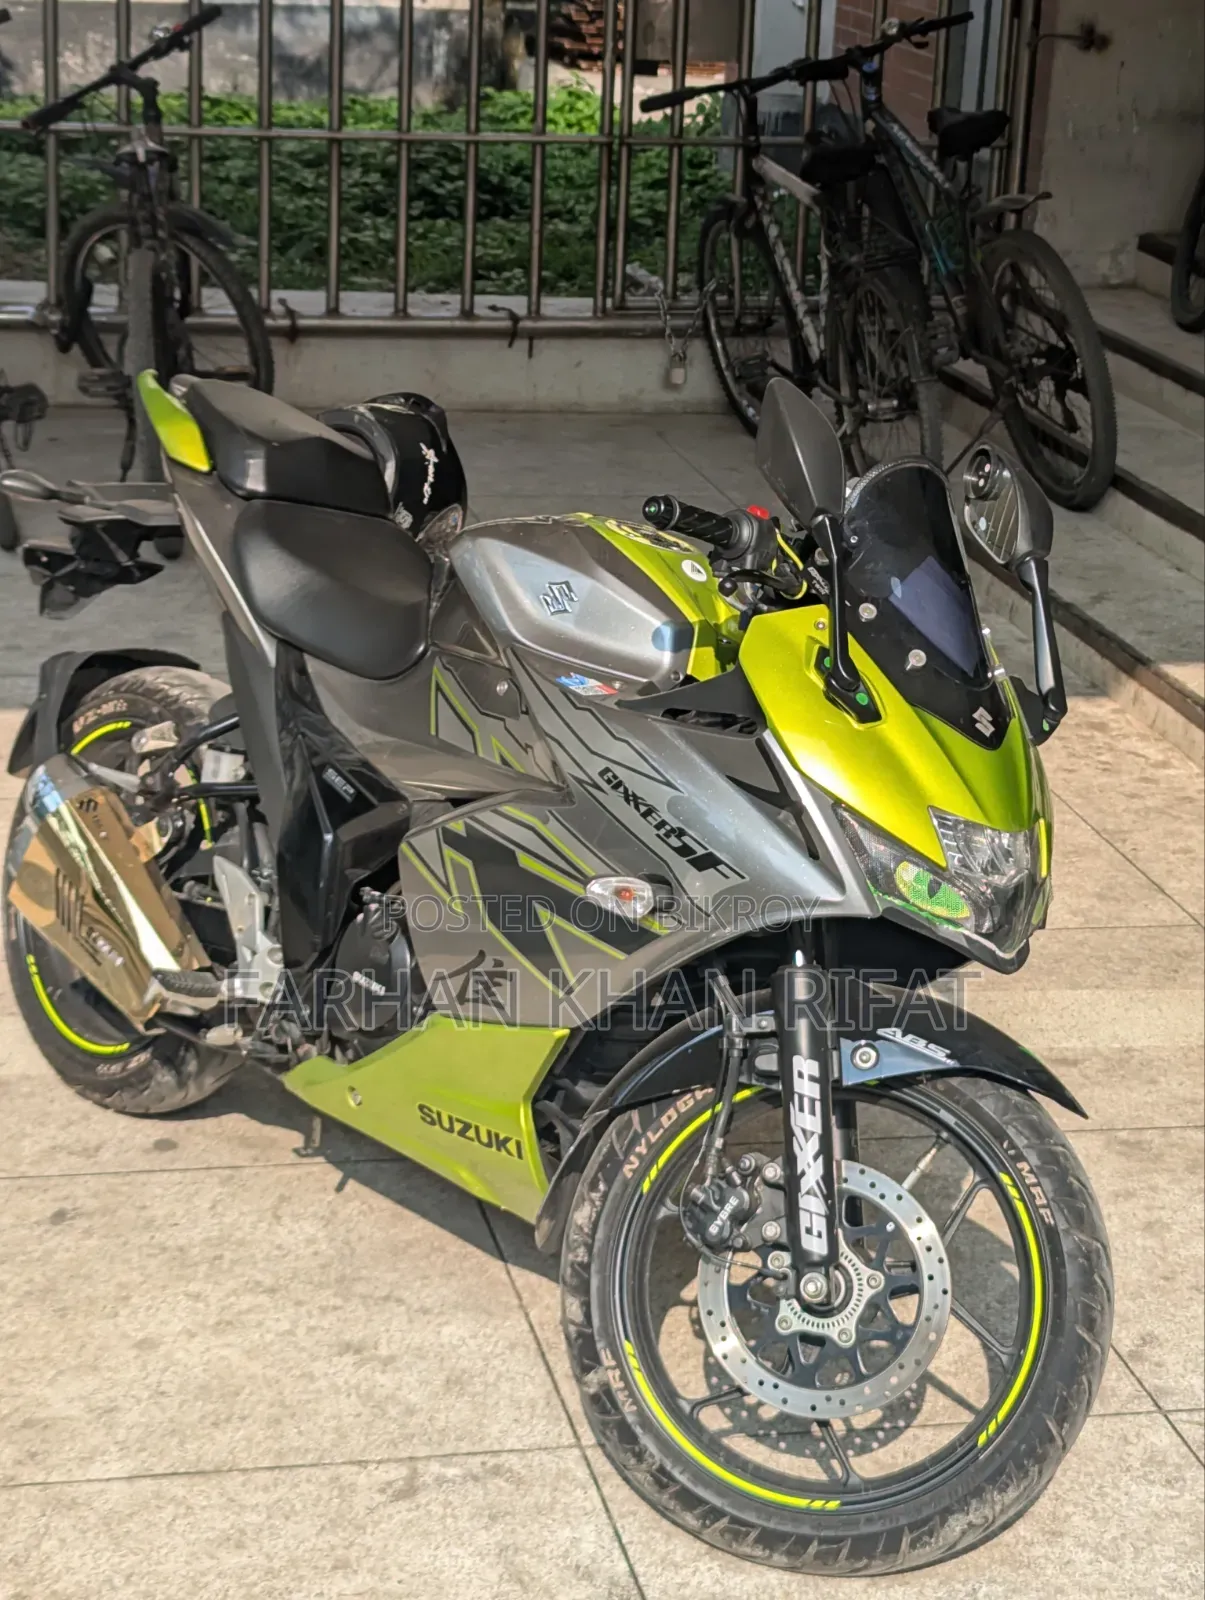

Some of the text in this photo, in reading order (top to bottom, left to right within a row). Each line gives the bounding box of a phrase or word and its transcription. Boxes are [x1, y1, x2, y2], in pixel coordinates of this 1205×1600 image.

[598, 766, 746, 880] GIXXER SF
[876, 1027, 952, 1059] ABS
[417, 1103, 525, 1161] SUZUKI
[789, 1054, 830, 1257] GIXXER
[603, 1346, 637, 1414] MRF
